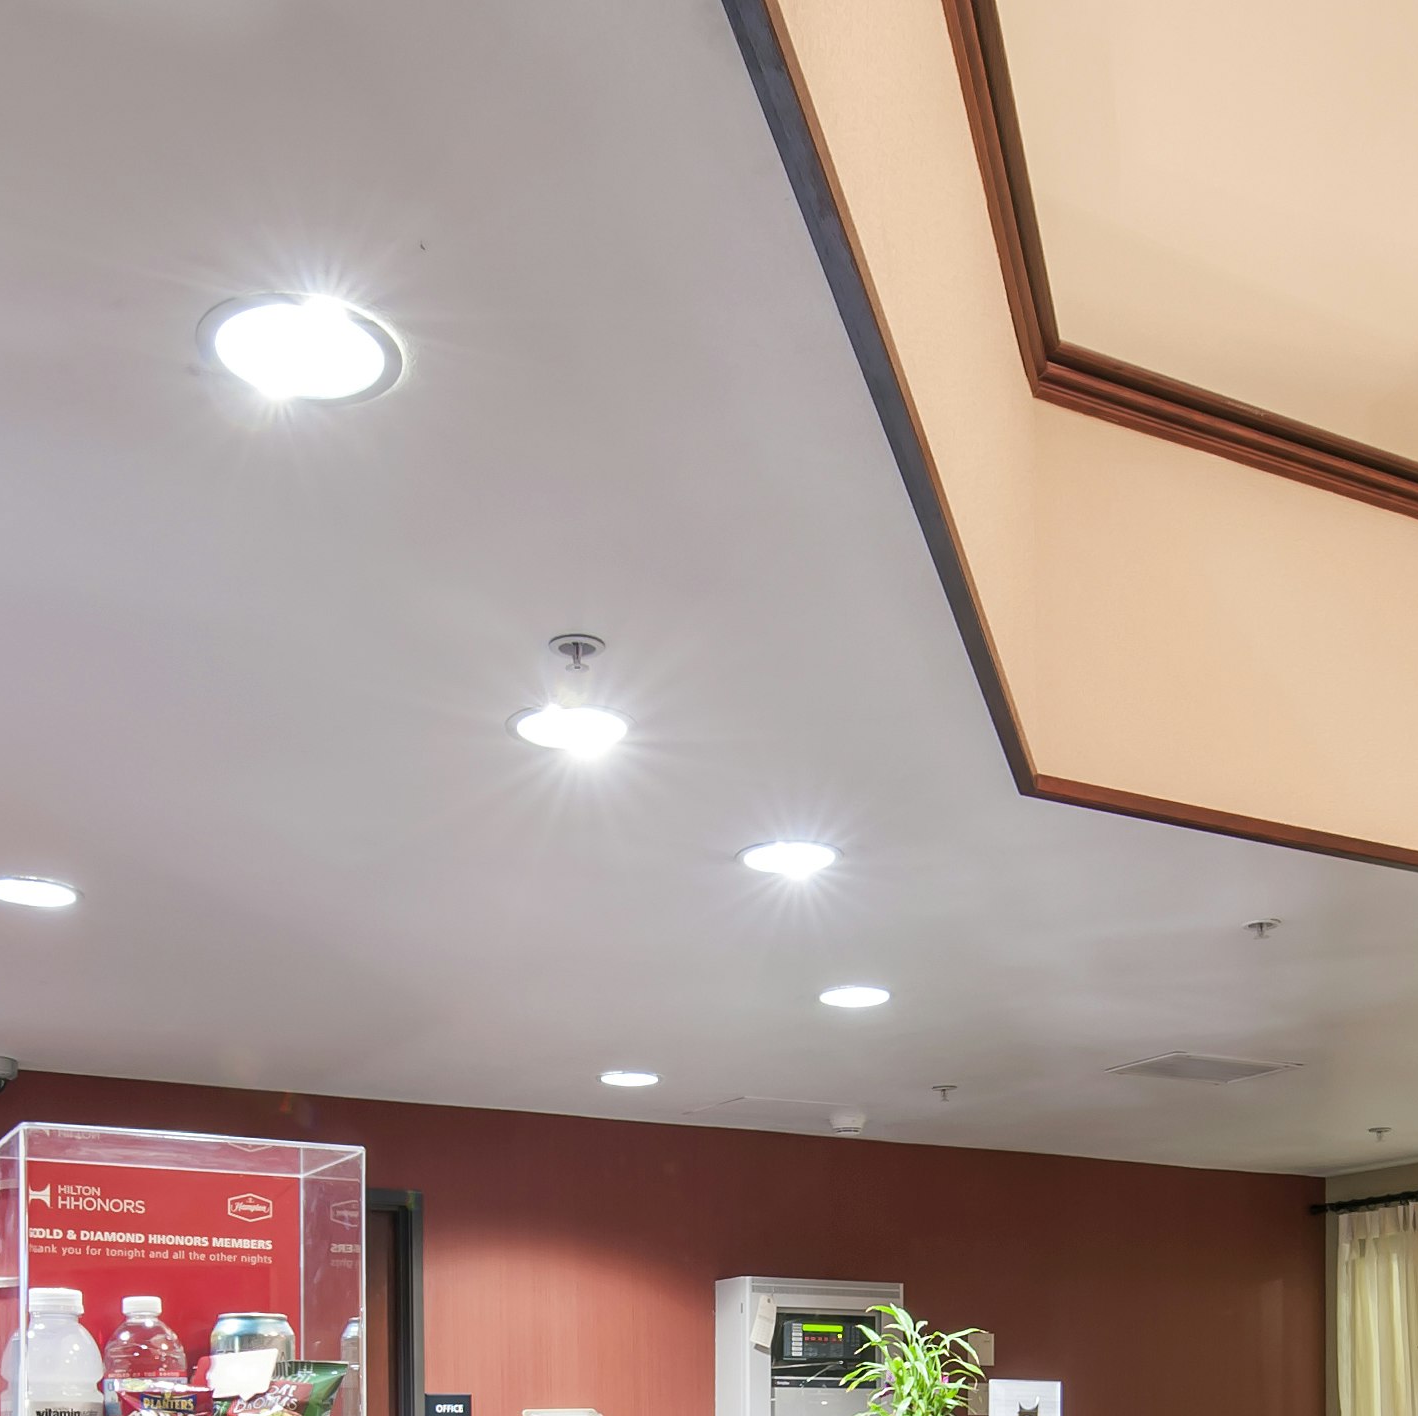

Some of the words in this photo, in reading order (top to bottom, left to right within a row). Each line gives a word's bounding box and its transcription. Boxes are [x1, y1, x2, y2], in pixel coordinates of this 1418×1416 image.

[57, 1184, 101, 1197] HILTON
[57, 1196, 146, 1214] HHONORS
[66, 1229, 77, 1241] &
[80, 1230, 145, 1244] DIAMOND
[148, 1233, 209, 1247] HHONORS
[212, 1236, 273, 1250] MEMBERS
[61, 1246, 82, 1256] you
[85, 1245, 102, 1256] for
[106, 1248, 145, 1260] tonight
[148, 1249, 169, 1259] and
[172, 1250, 185, 1260] all
[188, 1251, 206, 1261] the
[209, 1252, 238, 1263] other
[240, 1254, 273, 1266] nights
[142, 1397, 195, 1410] PLANTERS
[435, 1403, 464, 1414] OFFICE
